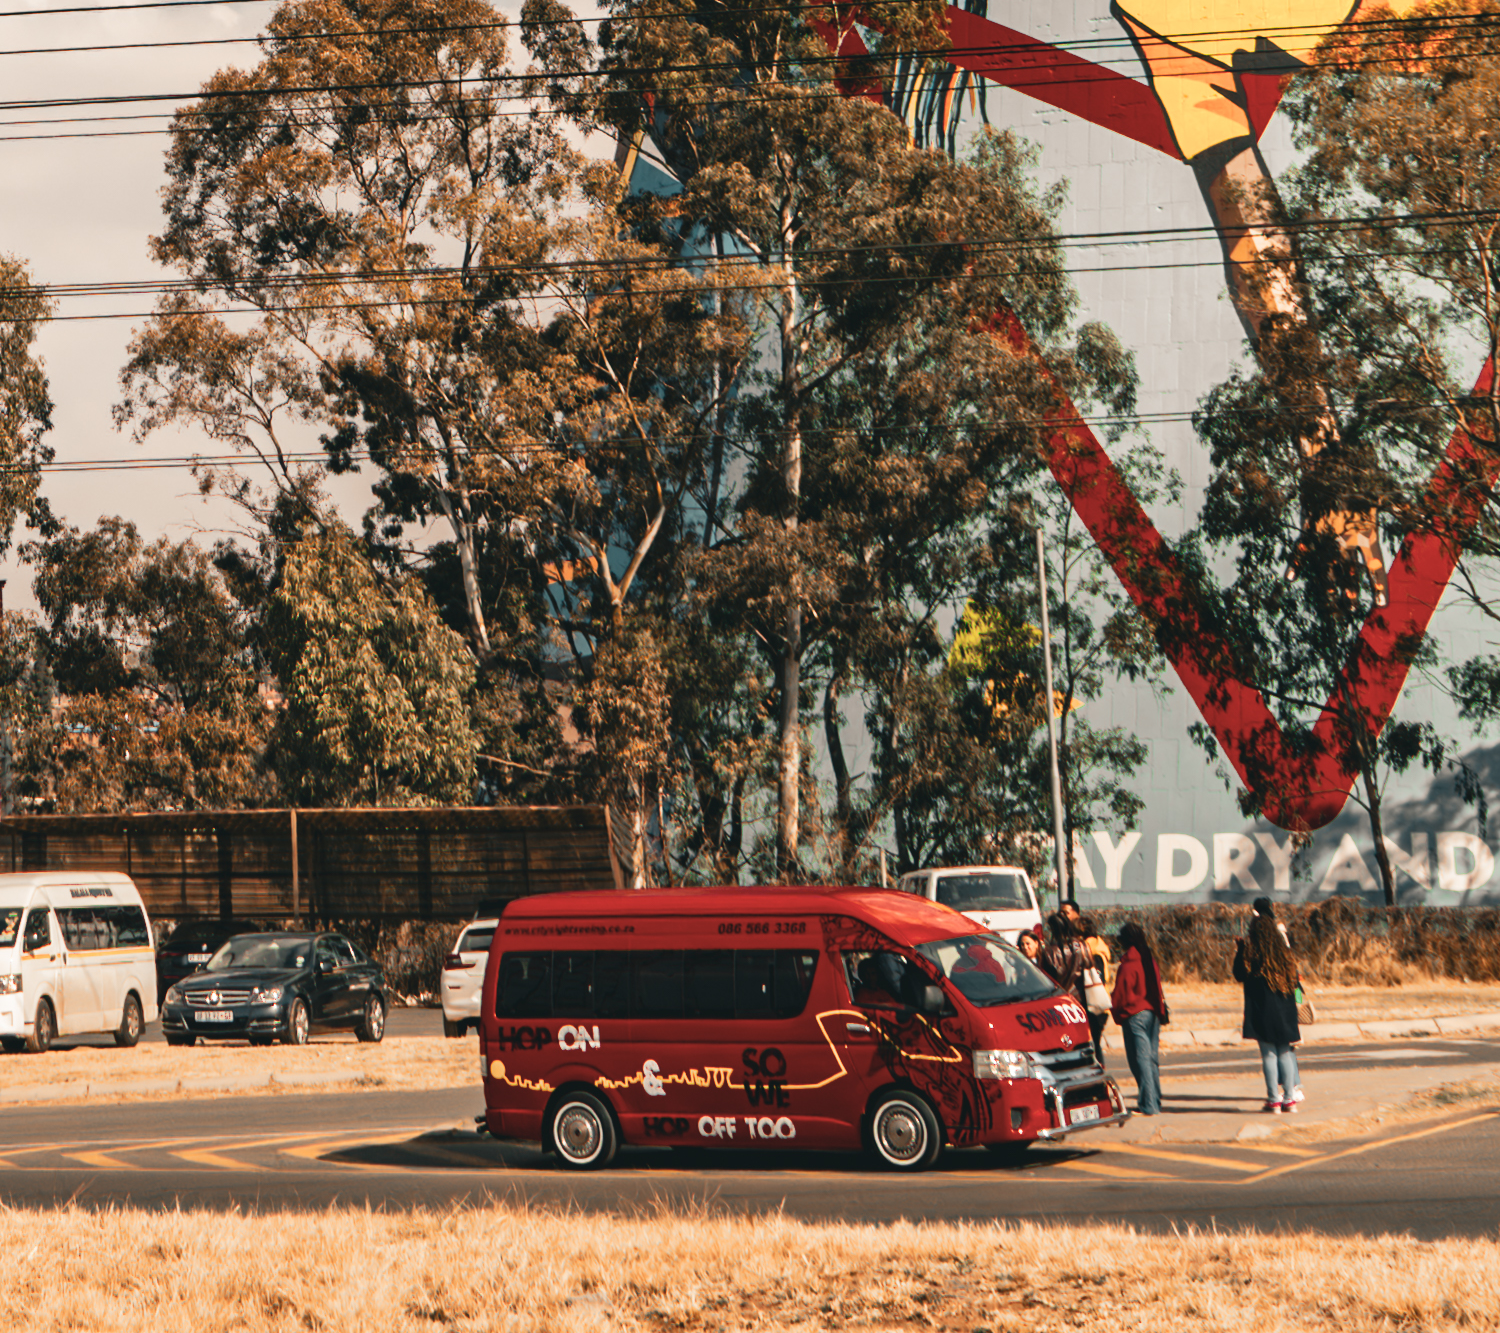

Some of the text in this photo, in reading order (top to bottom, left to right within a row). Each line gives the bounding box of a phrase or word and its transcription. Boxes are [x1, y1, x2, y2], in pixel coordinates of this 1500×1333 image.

[1155, 831, 1293, 892] DRY
[1319, 832, 1496, 893] AND
[498, 1025, 601, 1052] HOP ON
[741, 1047, 788, 1078] SO
[643, 1115, 797, 1139] HOP OFF TOO
